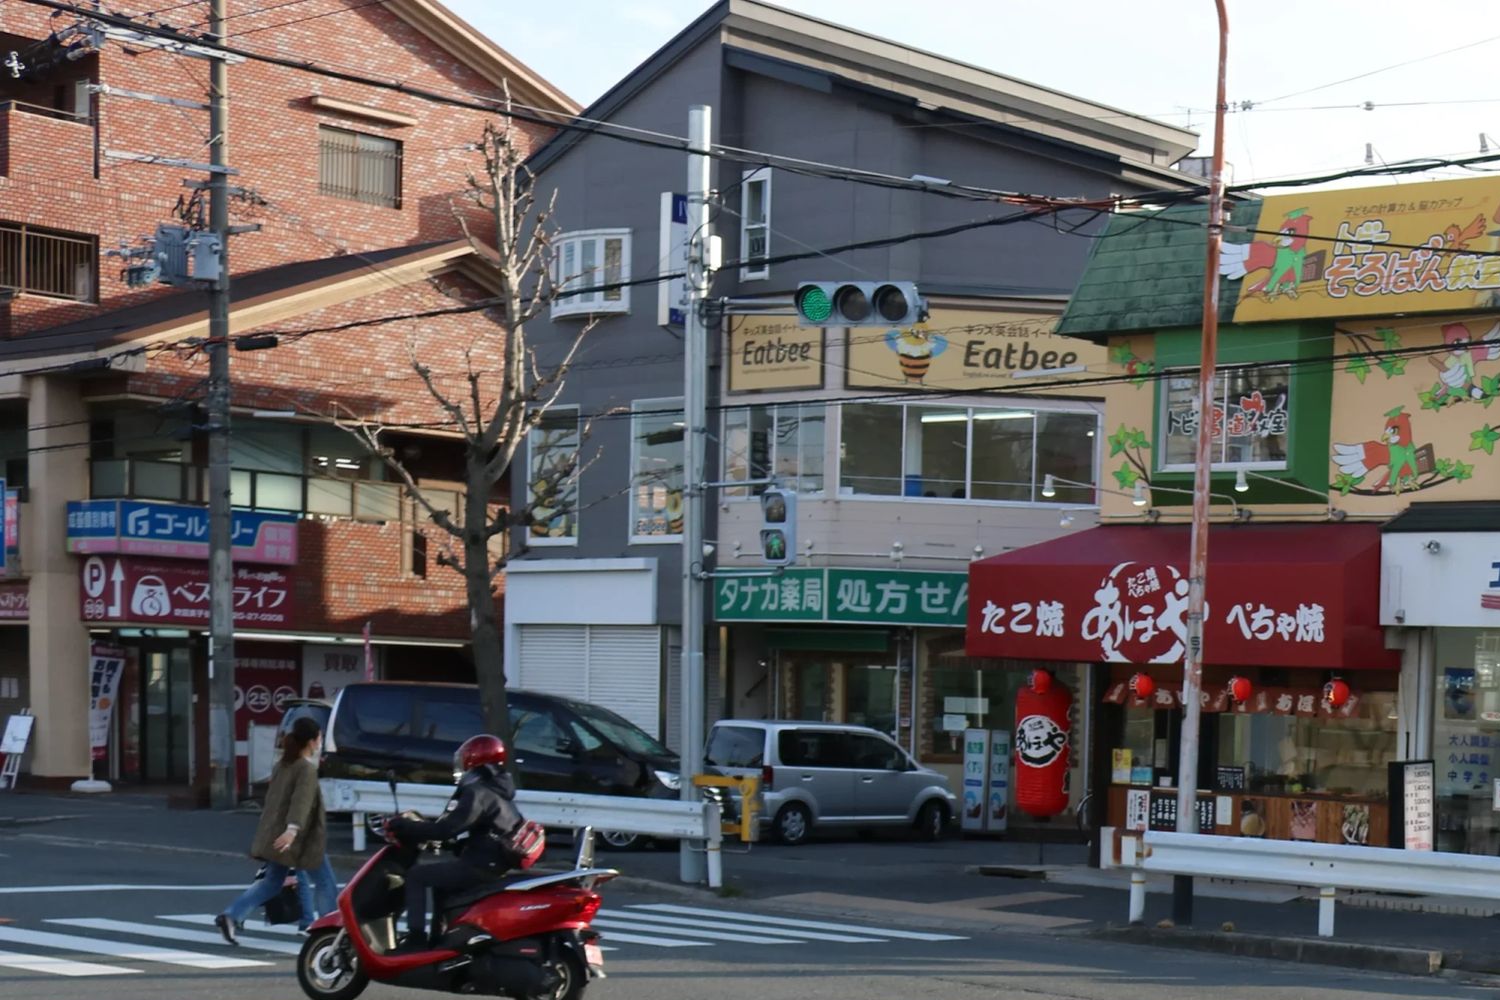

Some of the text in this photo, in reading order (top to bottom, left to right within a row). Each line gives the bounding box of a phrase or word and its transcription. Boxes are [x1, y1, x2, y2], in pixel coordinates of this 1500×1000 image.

[742, 337, 811, 366] Eatbee
[963, 340, 1078, 370] Eatbee
[155, 513, 254, 539] ゴールリー
[173, 581, 287, 609] ベスライフ
[720, 577, 822, 612] タナカ薬局
[981, 600, 1065, 637] たこ焼
[1226, 602, 1325, 643] ぺちゃ焼
